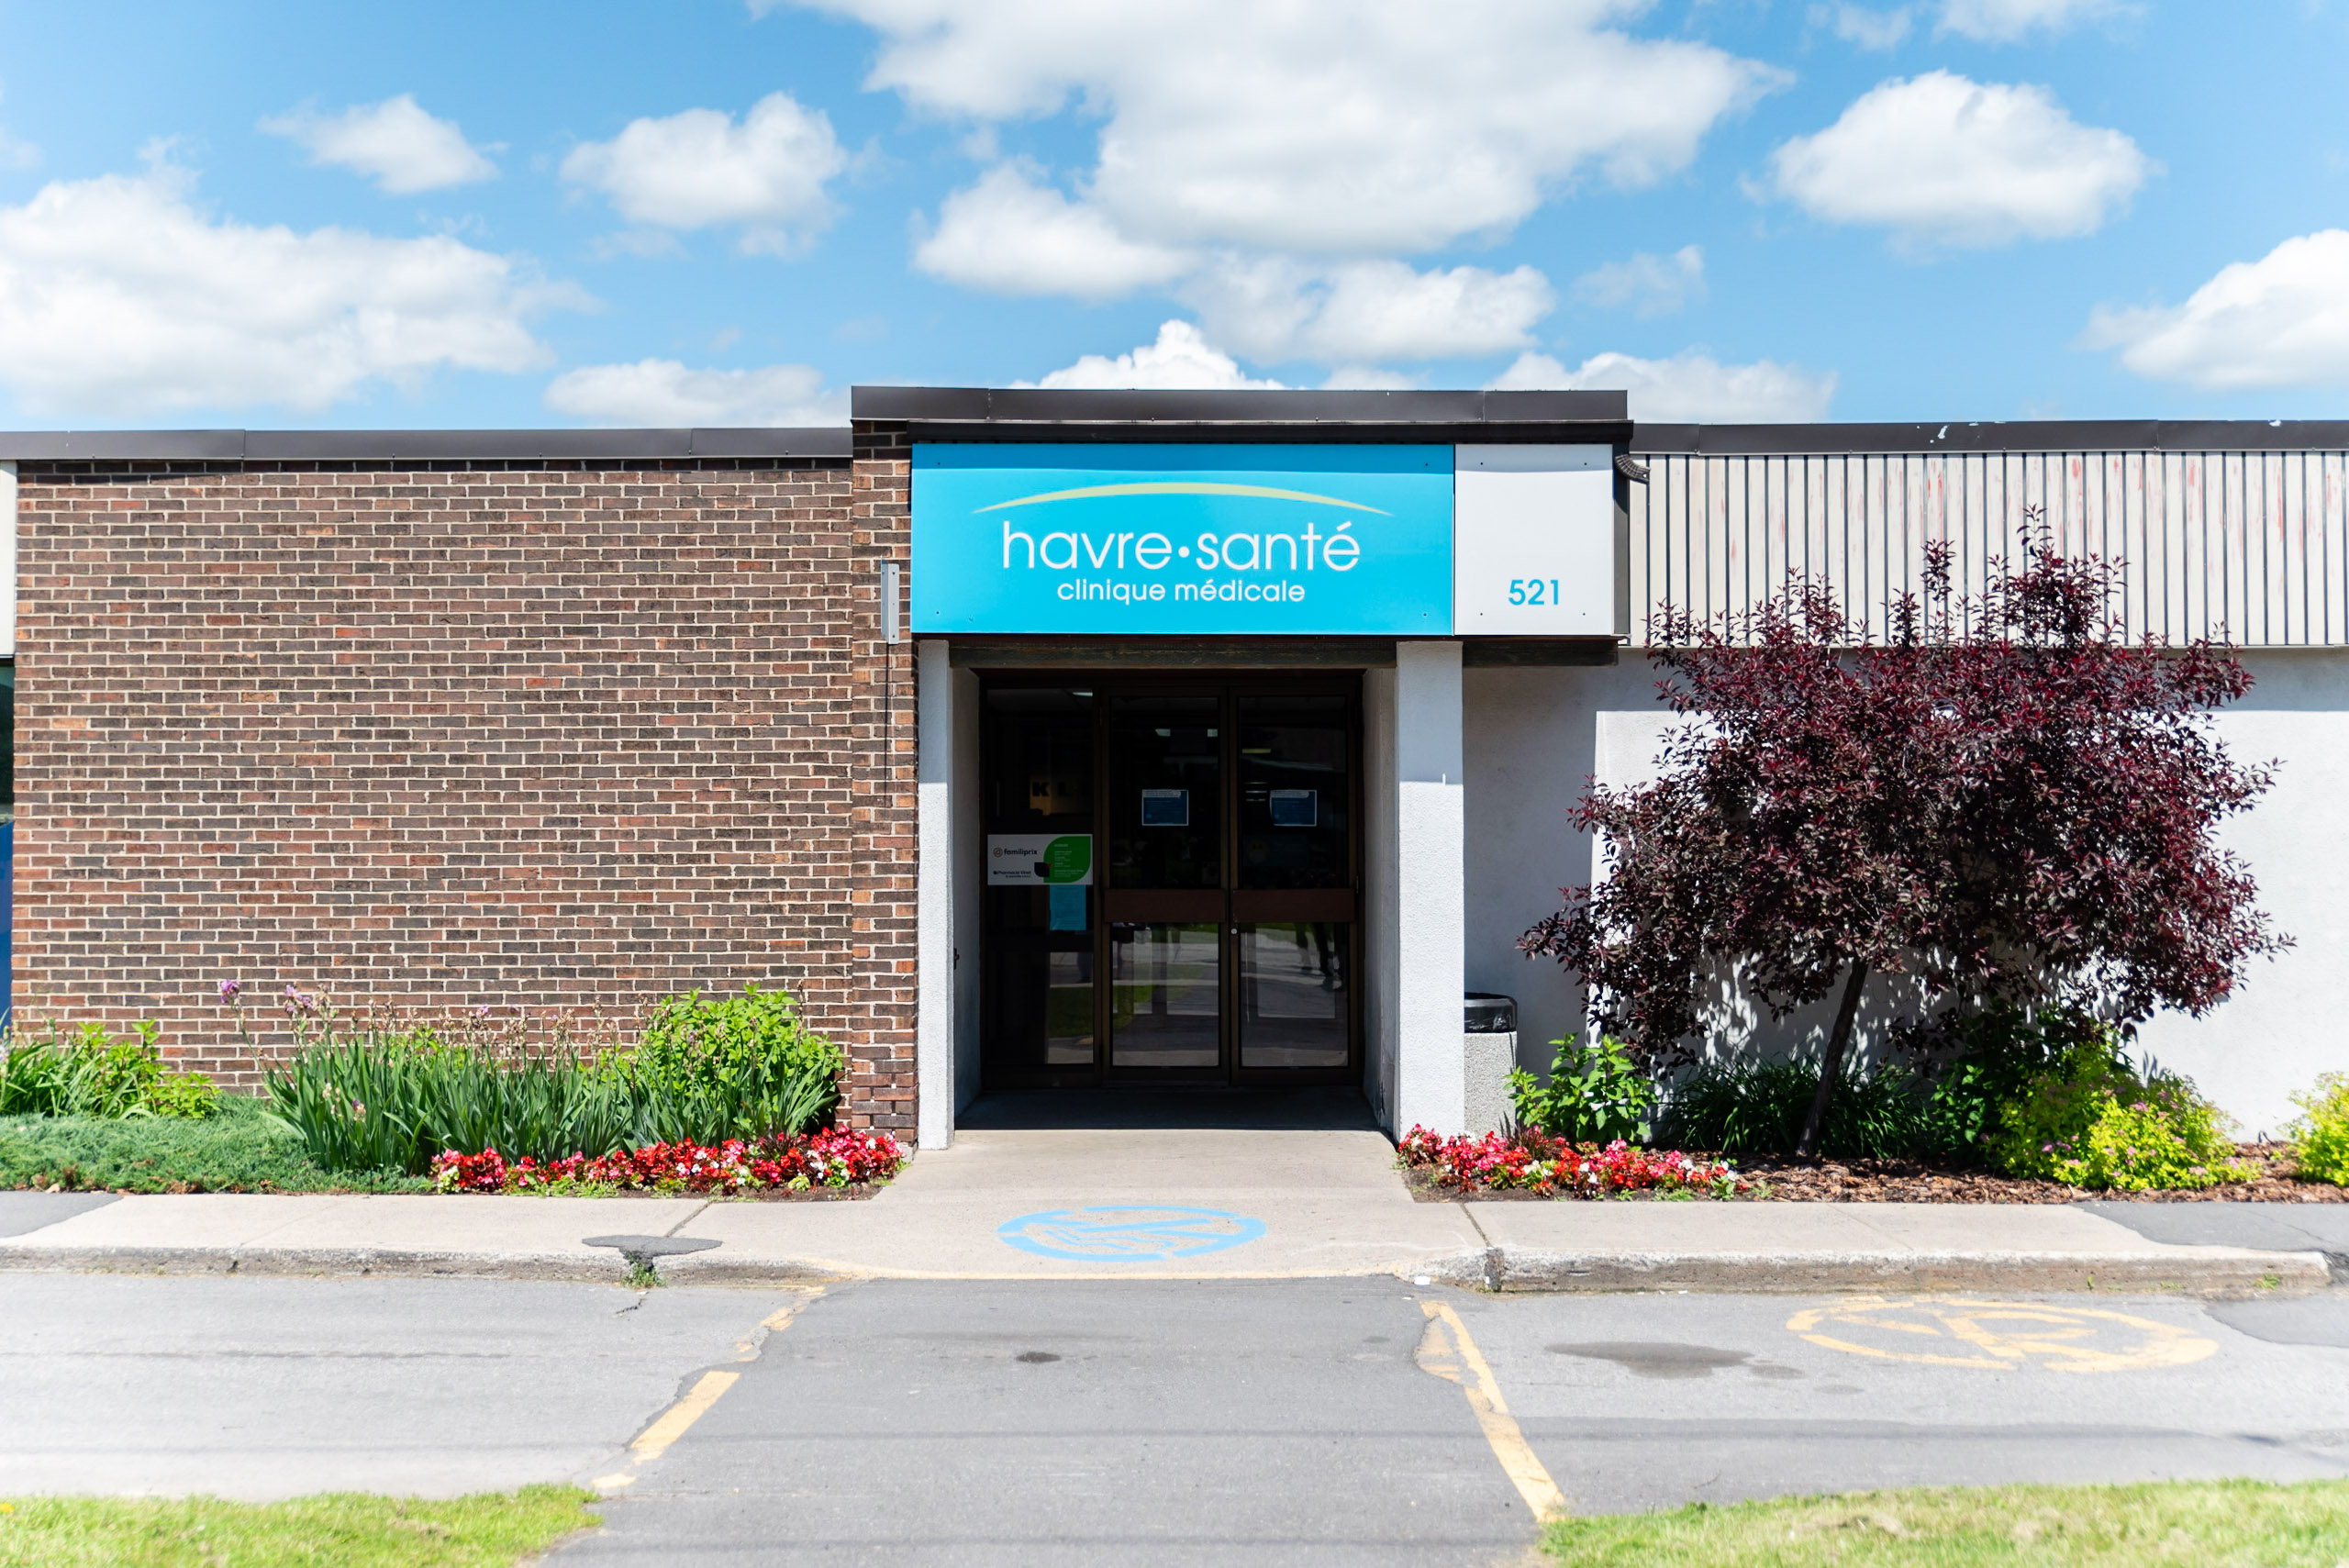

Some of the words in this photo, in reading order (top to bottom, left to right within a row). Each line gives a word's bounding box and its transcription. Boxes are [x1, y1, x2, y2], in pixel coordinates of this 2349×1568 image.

[1057, 579, 1166, 606] clinique
[1174, 578, 1306, 602] médicale
[1508, 578, 1559, 606] 521
[1004, 848, 1038, 857] familiprix
